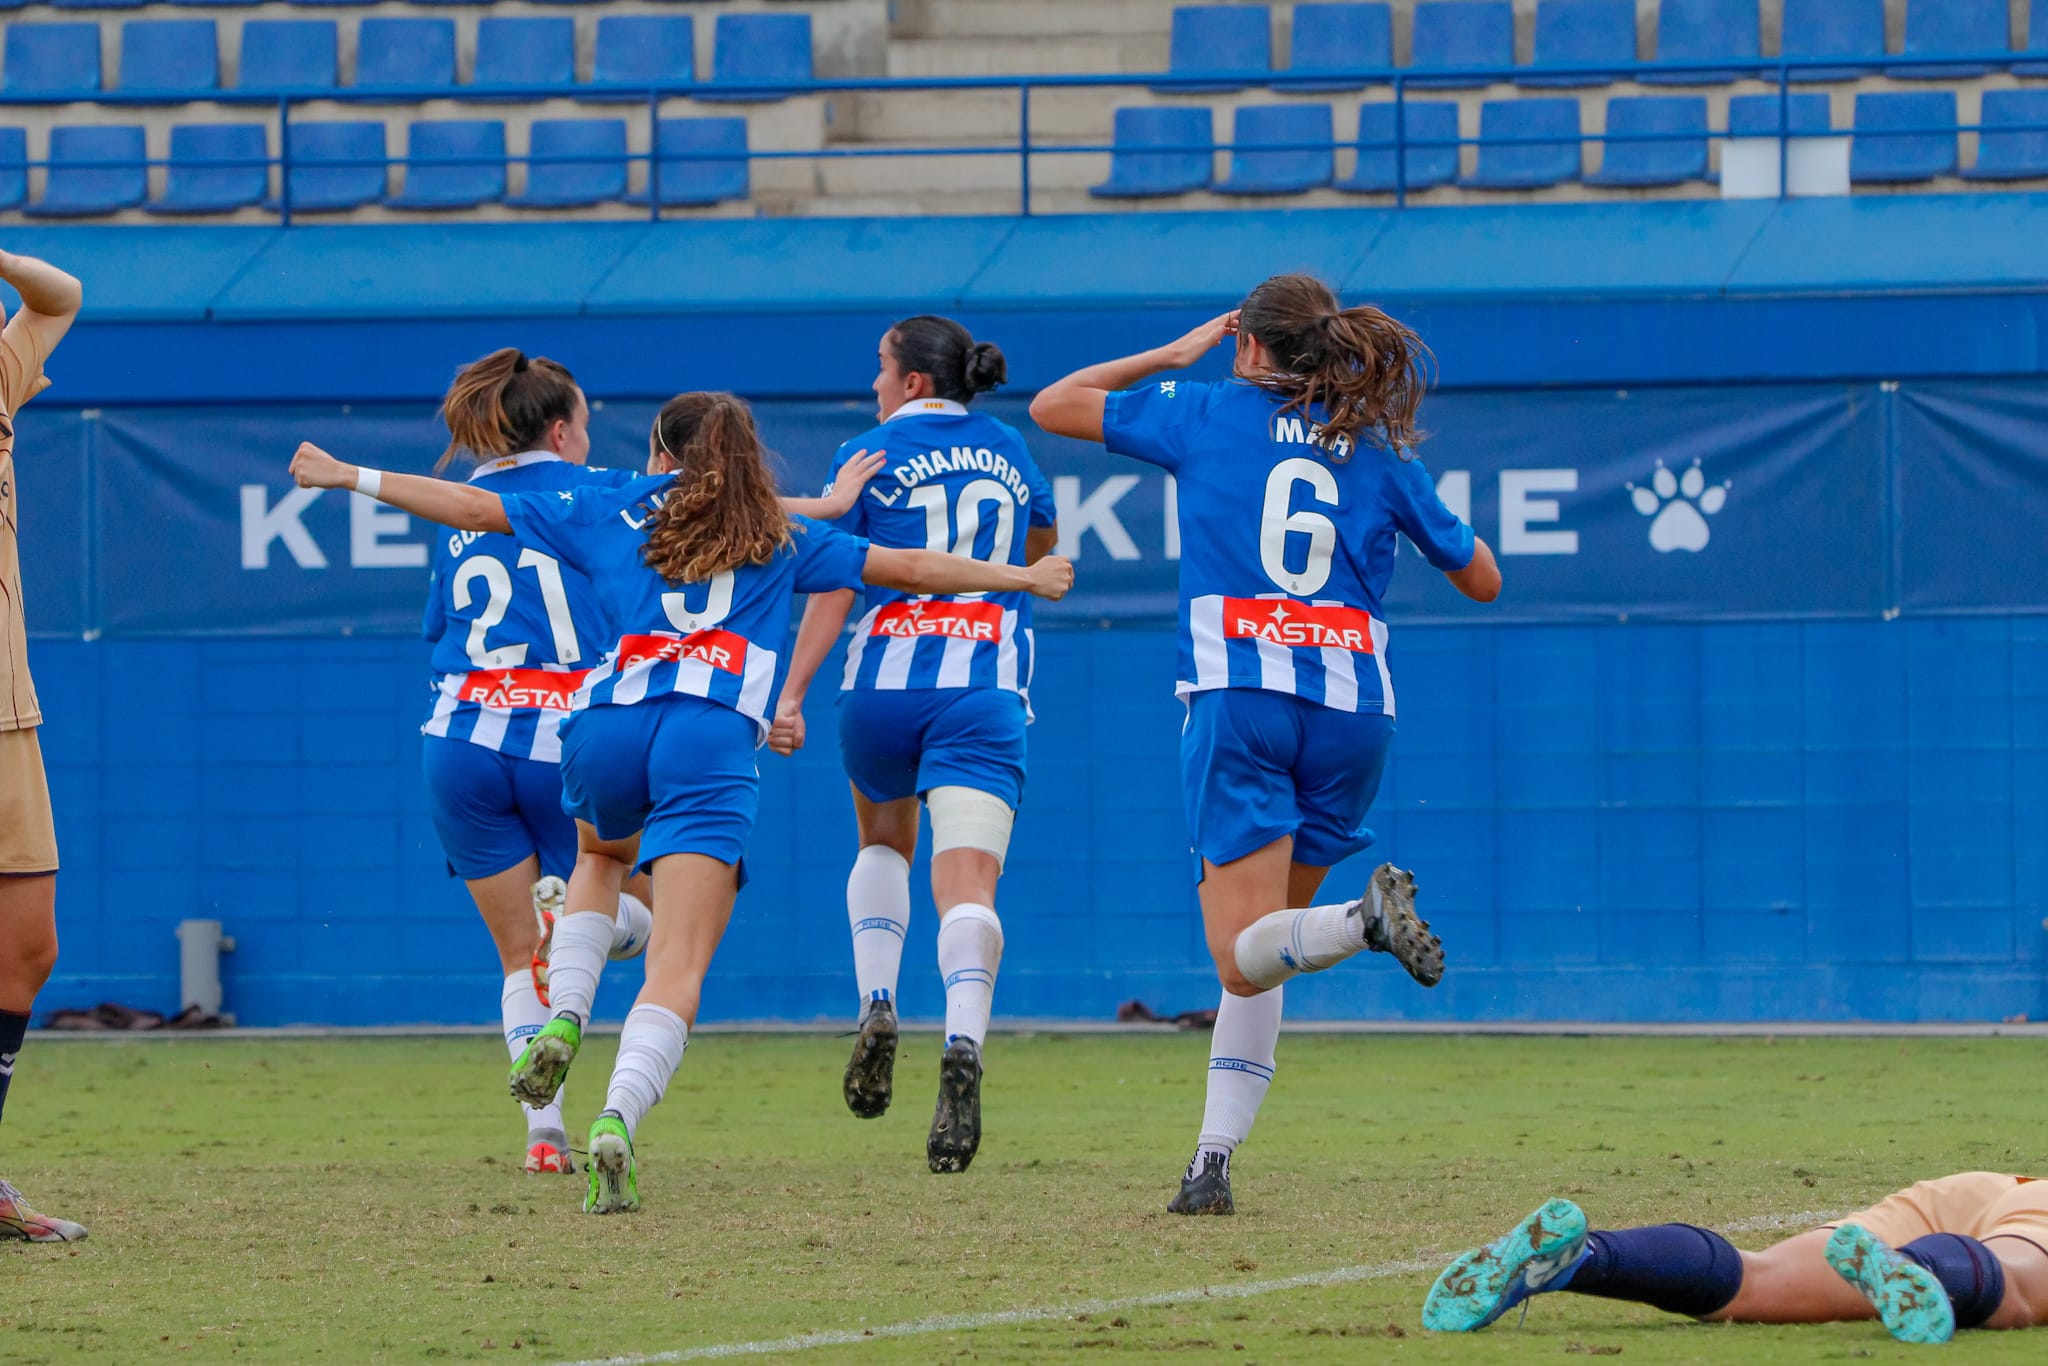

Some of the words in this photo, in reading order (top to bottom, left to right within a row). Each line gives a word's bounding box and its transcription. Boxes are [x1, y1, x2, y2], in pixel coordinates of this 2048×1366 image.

[906, 479, 1015, 598] 10
[1259, 457, 1339, 597] 6
[452, 547, 581, 667] 21
[879, 616, 994, 639] RASTAR
[1237, 616, 1364, 650] RASTAR
